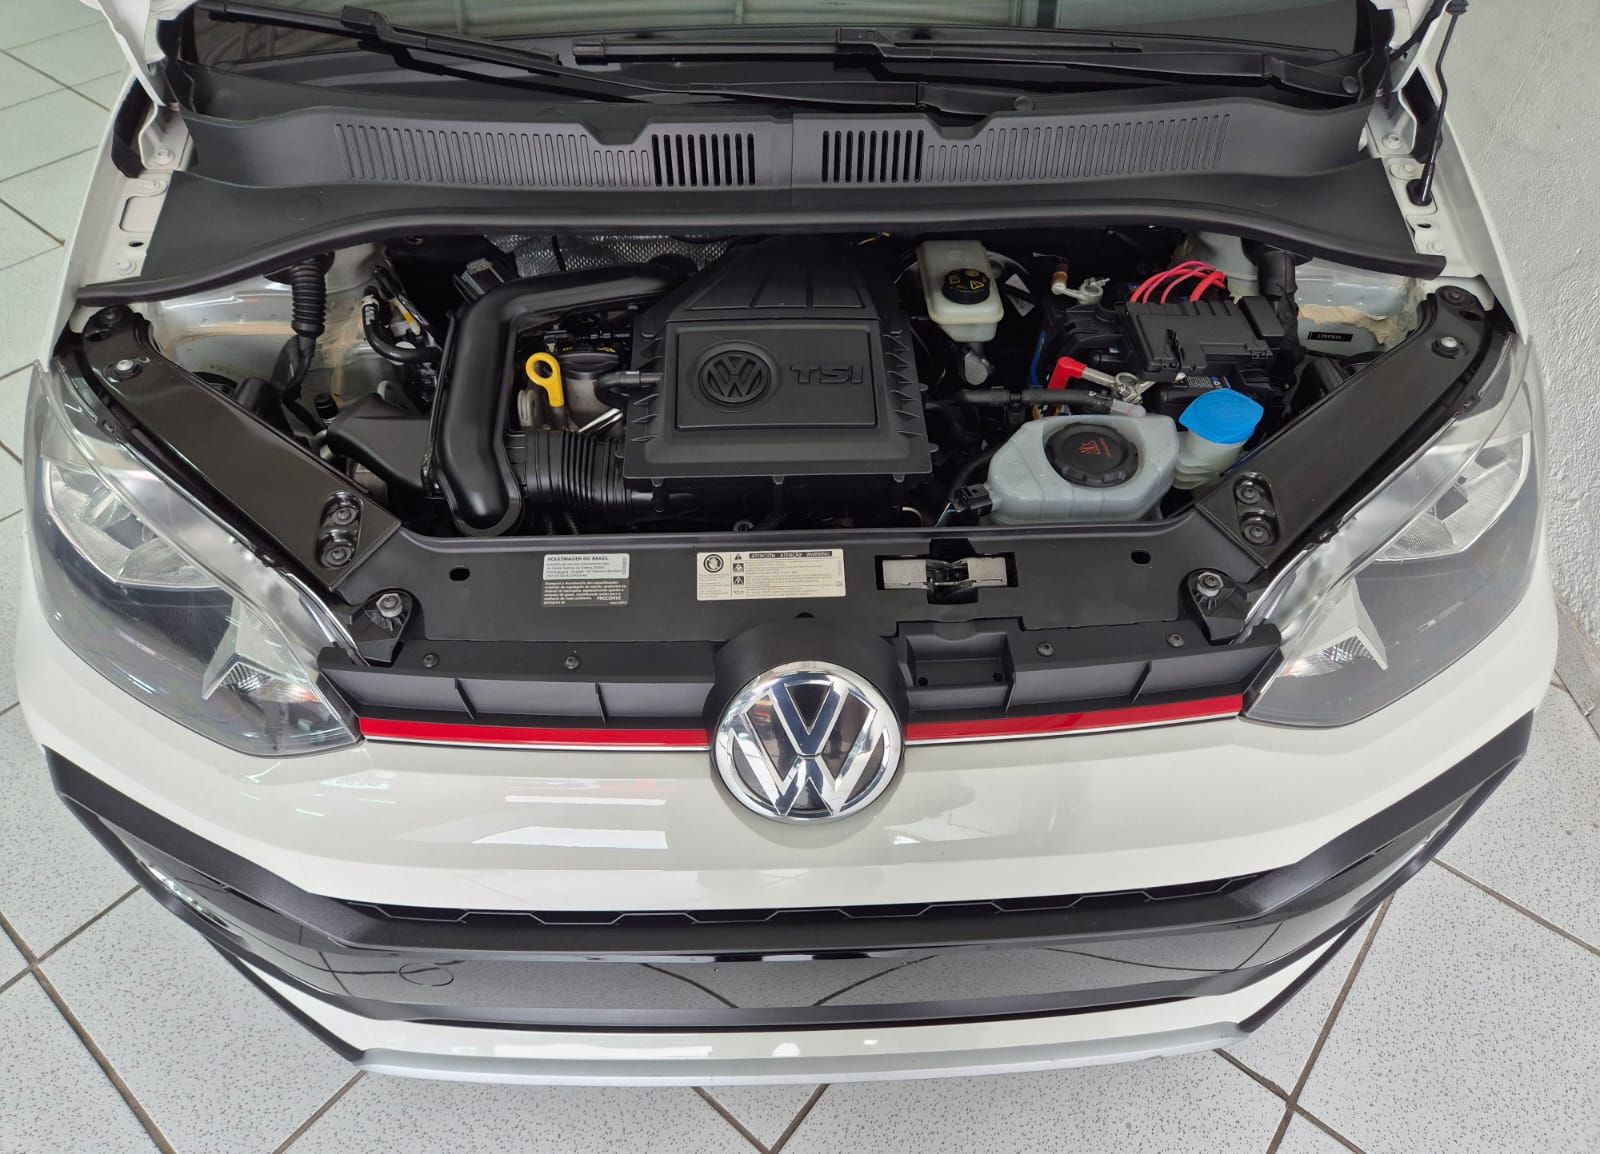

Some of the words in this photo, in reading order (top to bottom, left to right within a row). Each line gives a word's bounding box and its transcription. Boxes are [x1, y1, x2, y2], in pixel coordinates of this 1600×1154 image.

[702, 351, 770, 403] VW
[791, 363, 864, 384] TSI
[715, 662, 901, 821] VW
